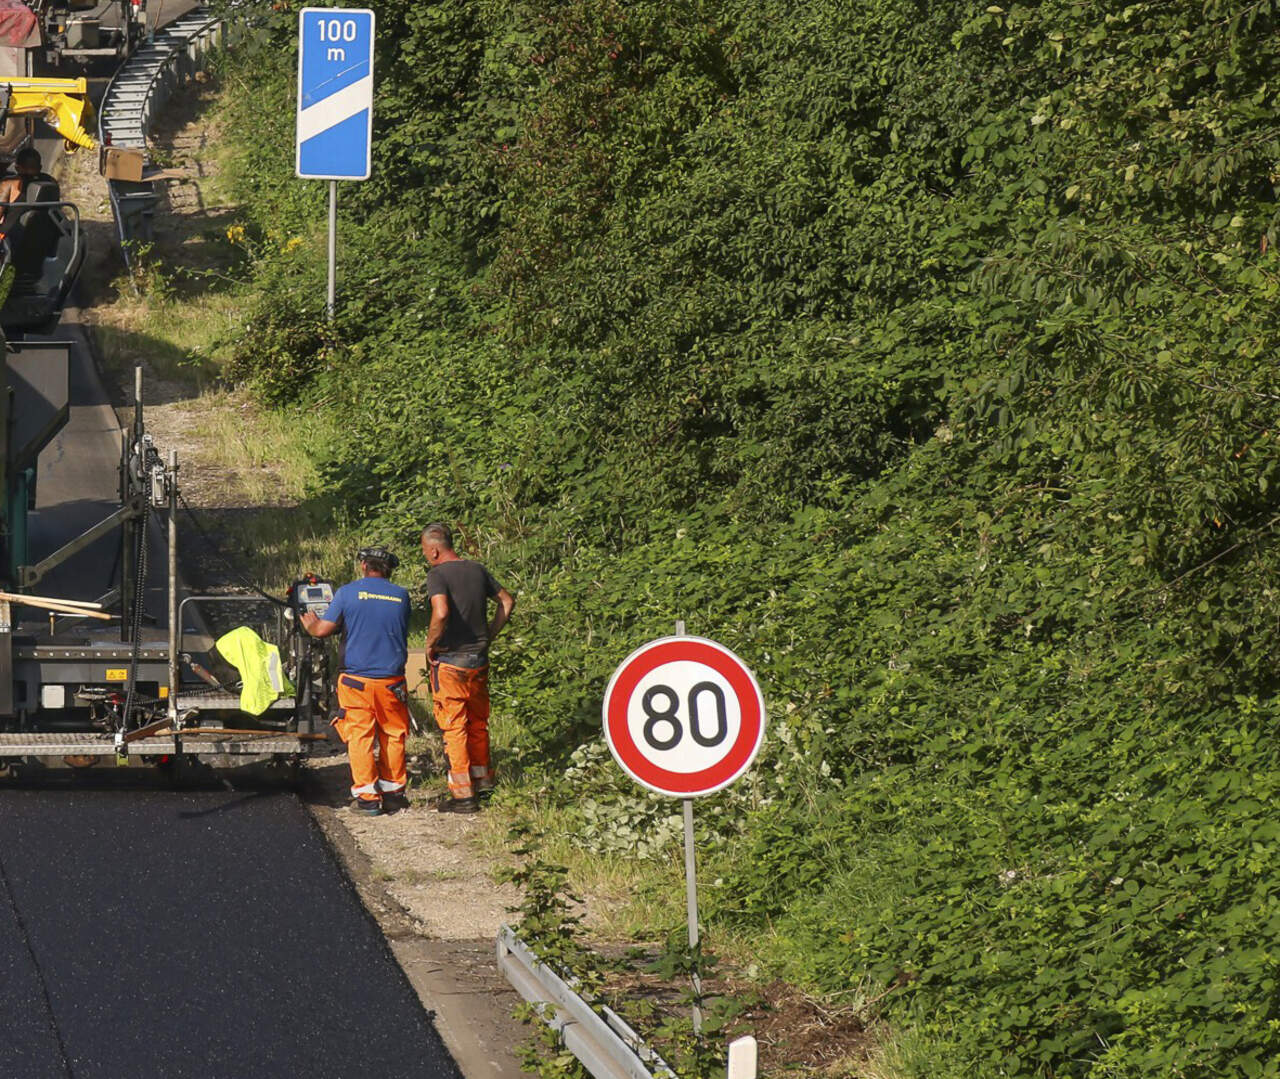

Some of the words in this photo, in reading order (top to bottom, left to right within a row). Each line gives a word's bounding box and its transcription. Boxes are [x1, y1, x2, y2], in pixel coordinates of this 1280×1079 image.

[318, 20, 357, 42] 100
[327, 47, 345, 61] m
[642, 680, 728, 751] 80
